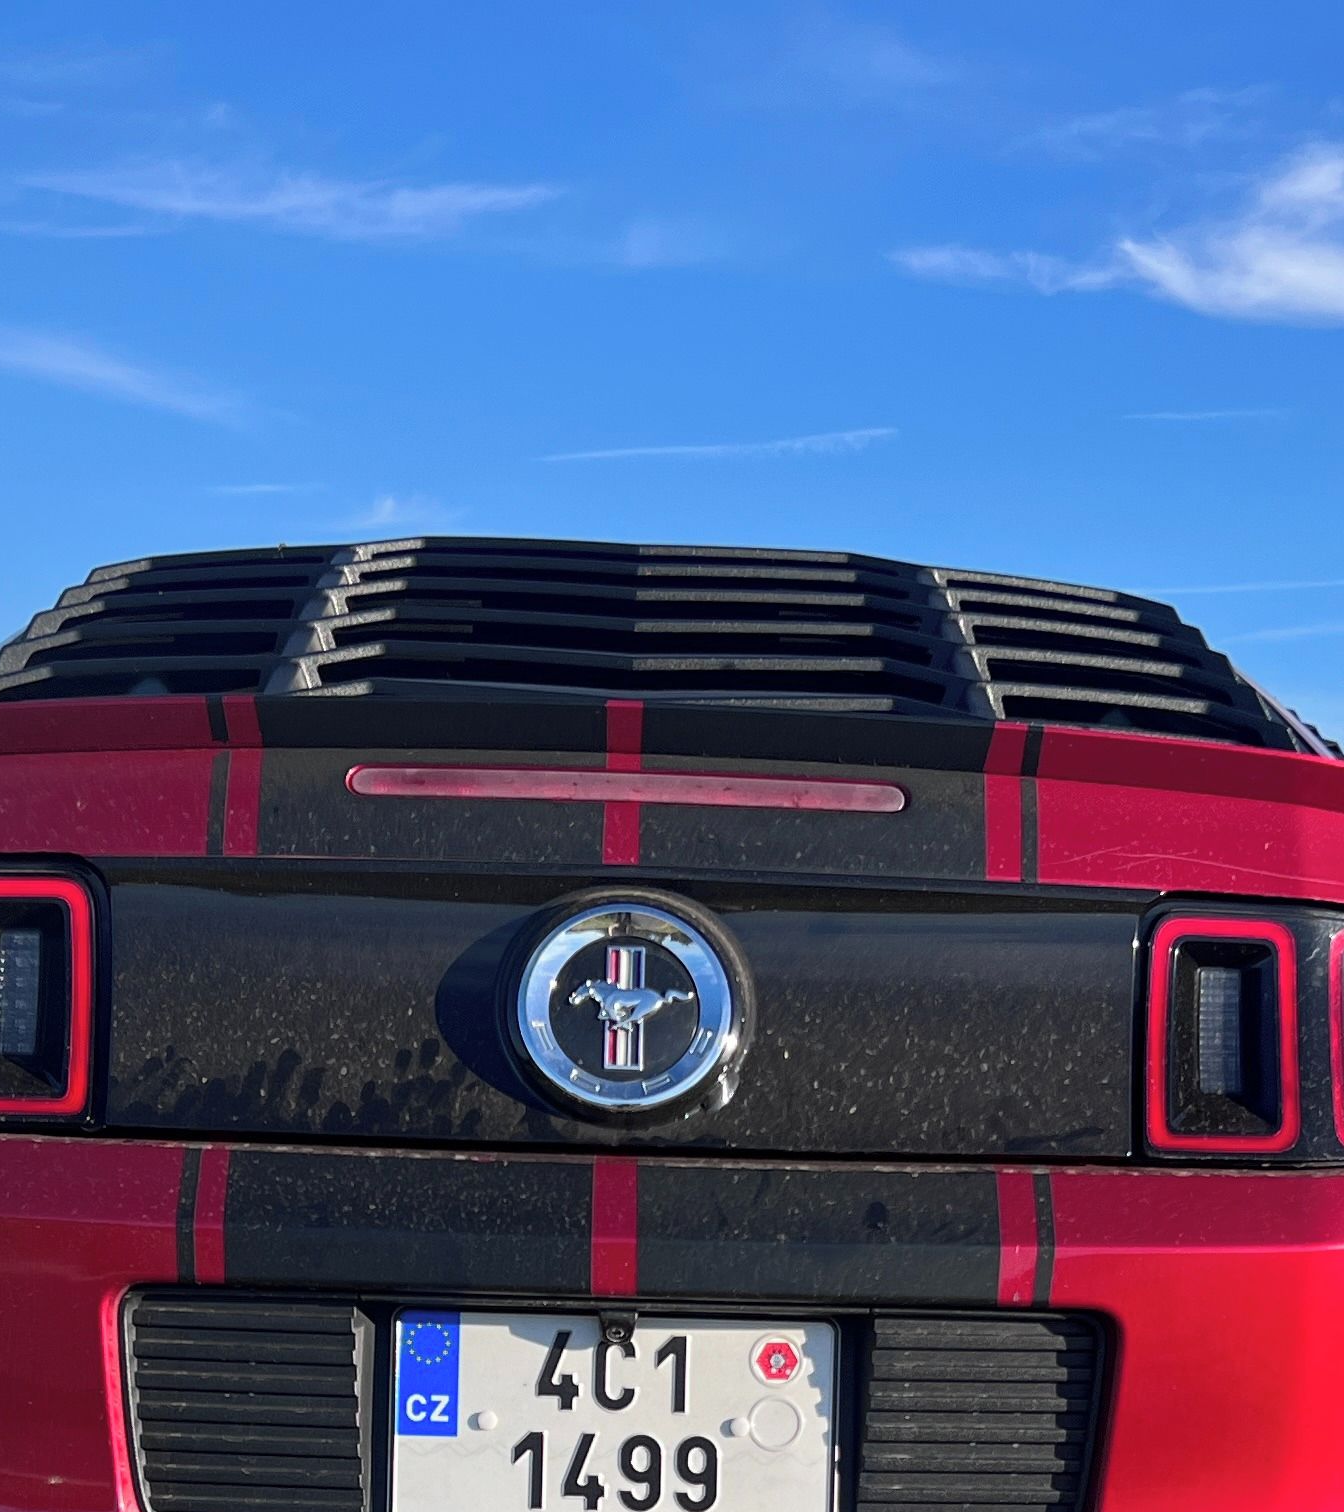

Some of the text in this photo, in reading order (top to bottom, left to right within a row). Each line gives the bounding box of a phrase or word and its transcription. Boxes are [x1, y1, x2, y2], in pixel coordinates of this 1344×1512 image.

[405, 1394, 450, 1423] CZ
[535, 1331, 689, 1414] 4C1
[511, 1431, 718, 1512] 1499
